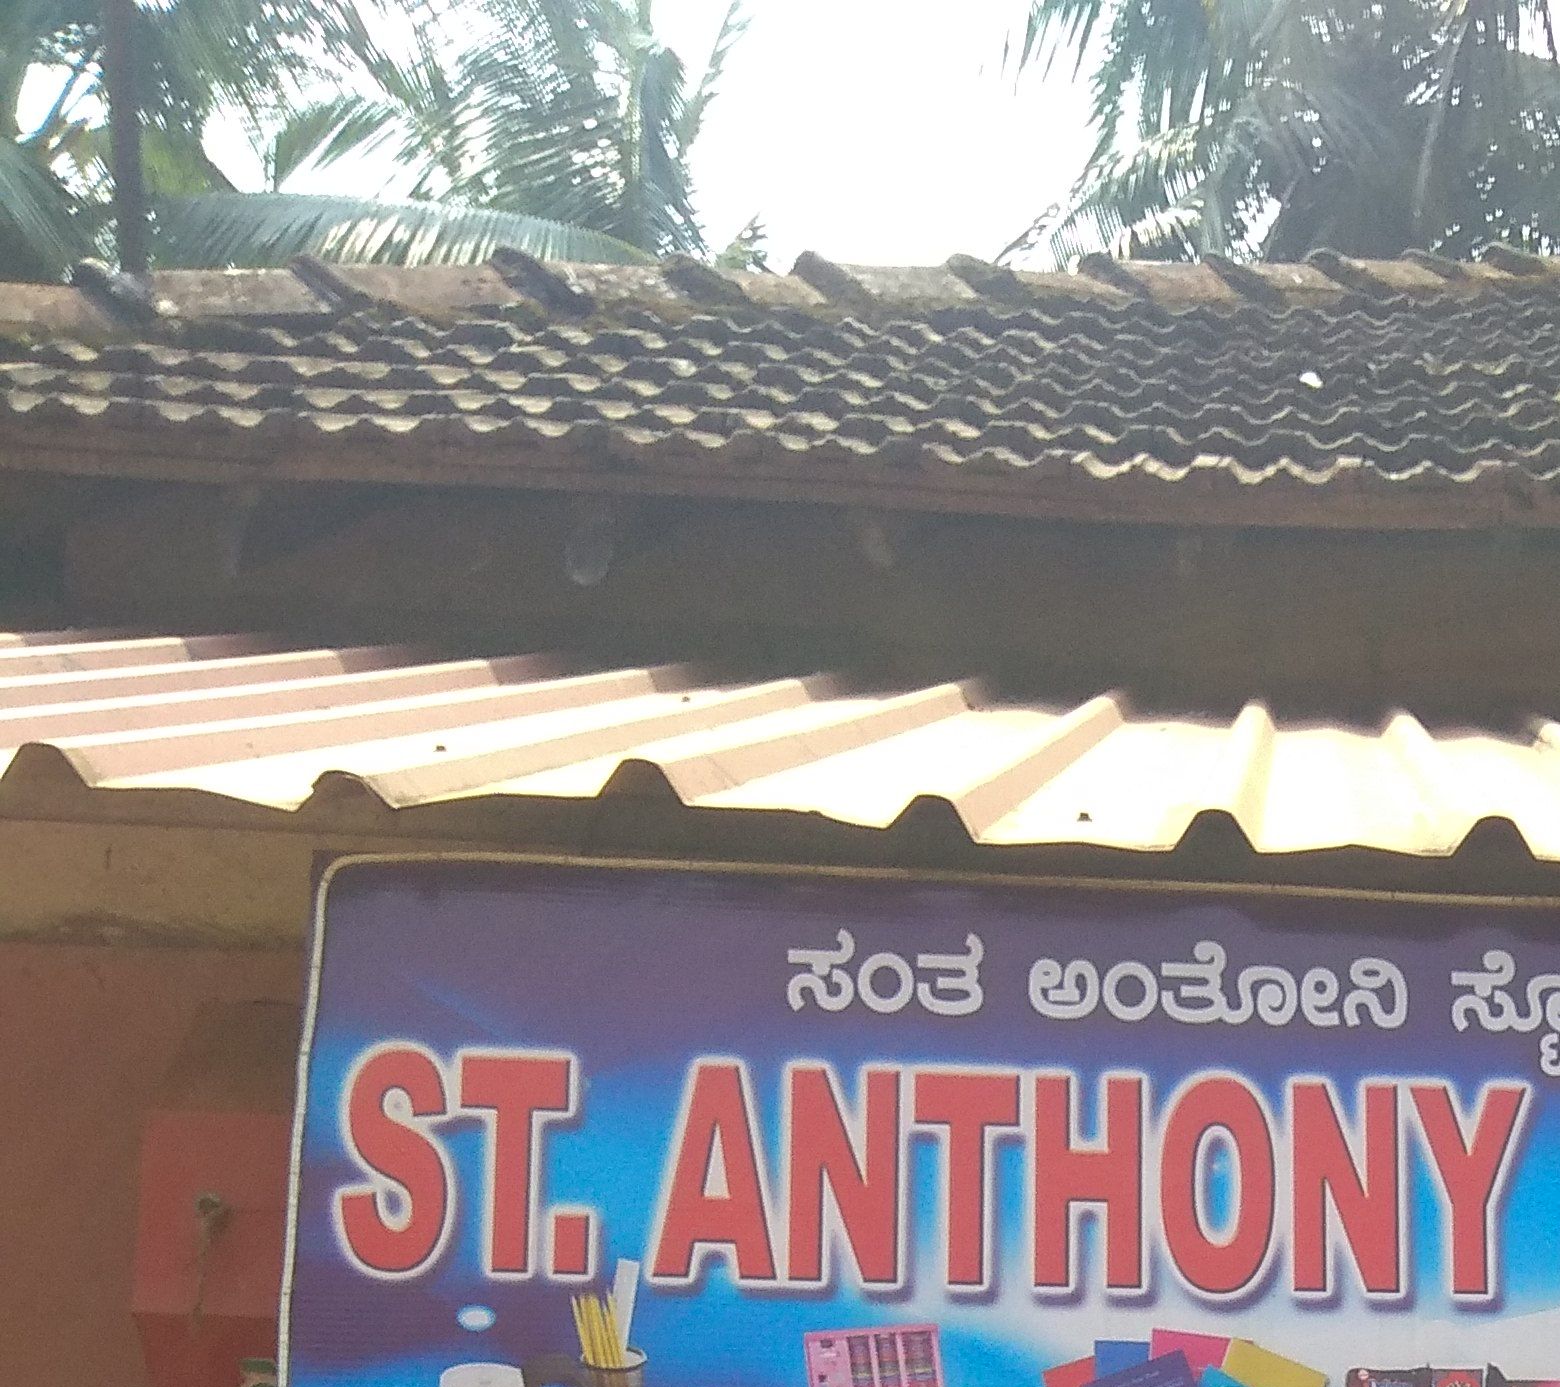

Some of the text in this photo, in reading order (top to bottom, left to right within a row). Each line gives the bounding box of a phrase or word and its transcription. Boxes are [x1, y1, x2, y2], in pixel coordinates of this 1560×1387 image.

[786, 929, 986, 1017] ಸಂತ
[1027, 940, 1408, 1029] ಅಂತೋನಿ
[336, 1045, 594, 1279] ST.
[650, 1060, 1532, 1303] ANTHONY
